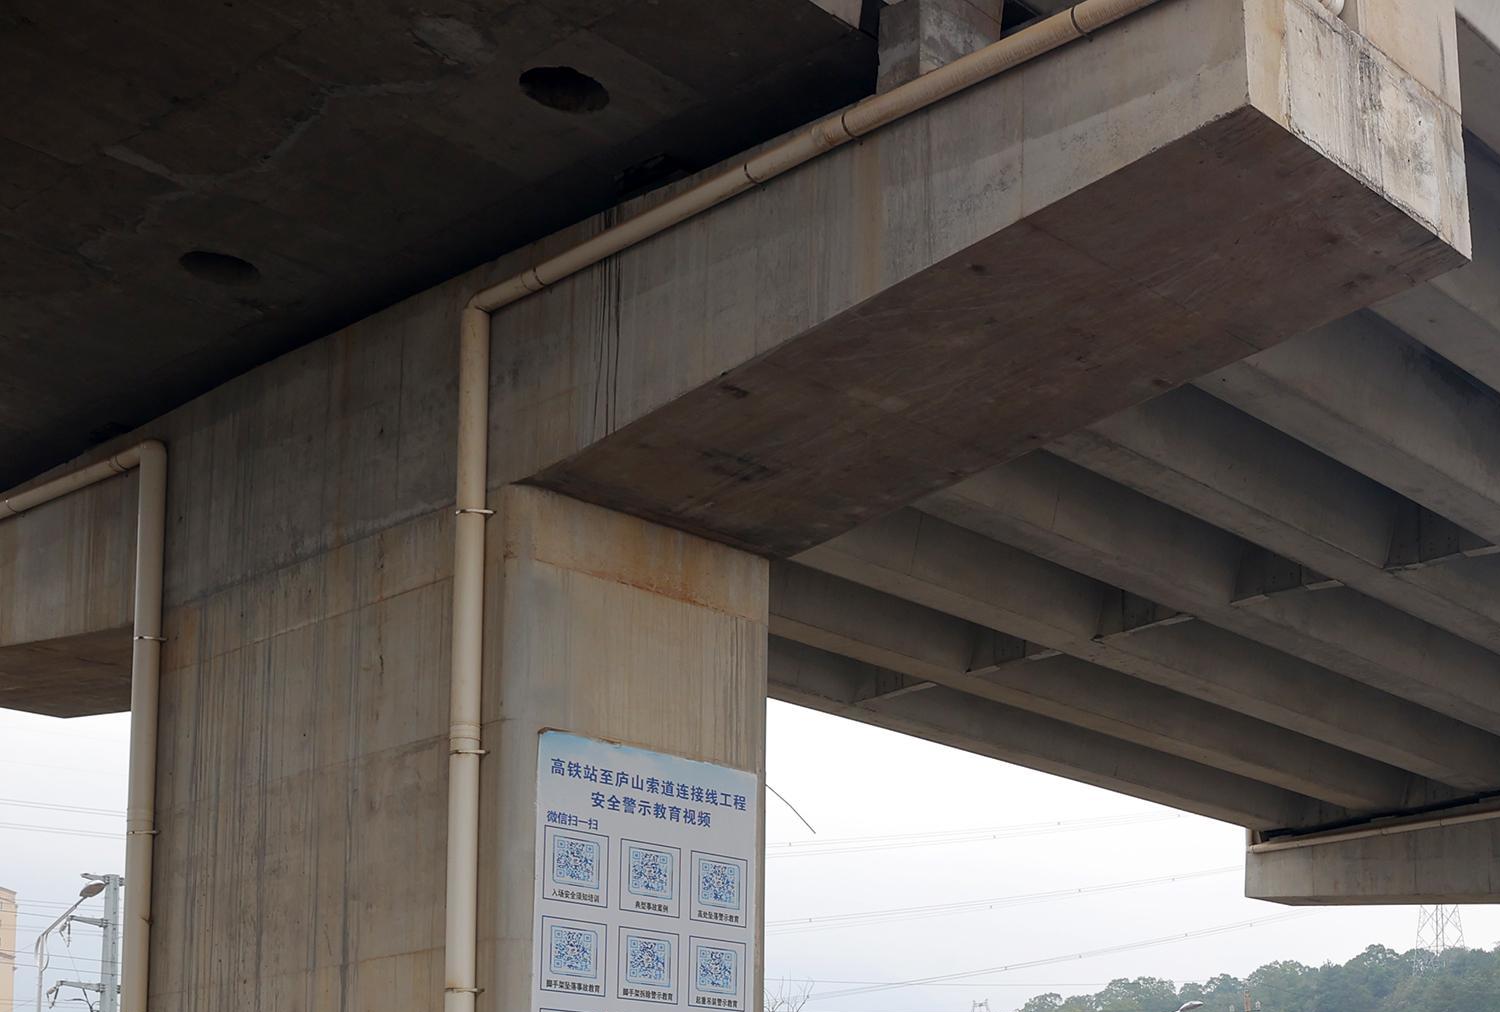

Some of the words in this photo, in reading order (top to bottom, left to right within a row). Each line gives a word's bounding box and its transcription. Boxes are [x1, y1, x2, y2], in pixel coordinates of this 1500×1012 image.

[551, 757, 747, 811] 高铁站至庐山索道连接线工程
[547, 811, 598, 830] 微信扫一扫
[591, 792, 711, 827] 安全警示教育视频
